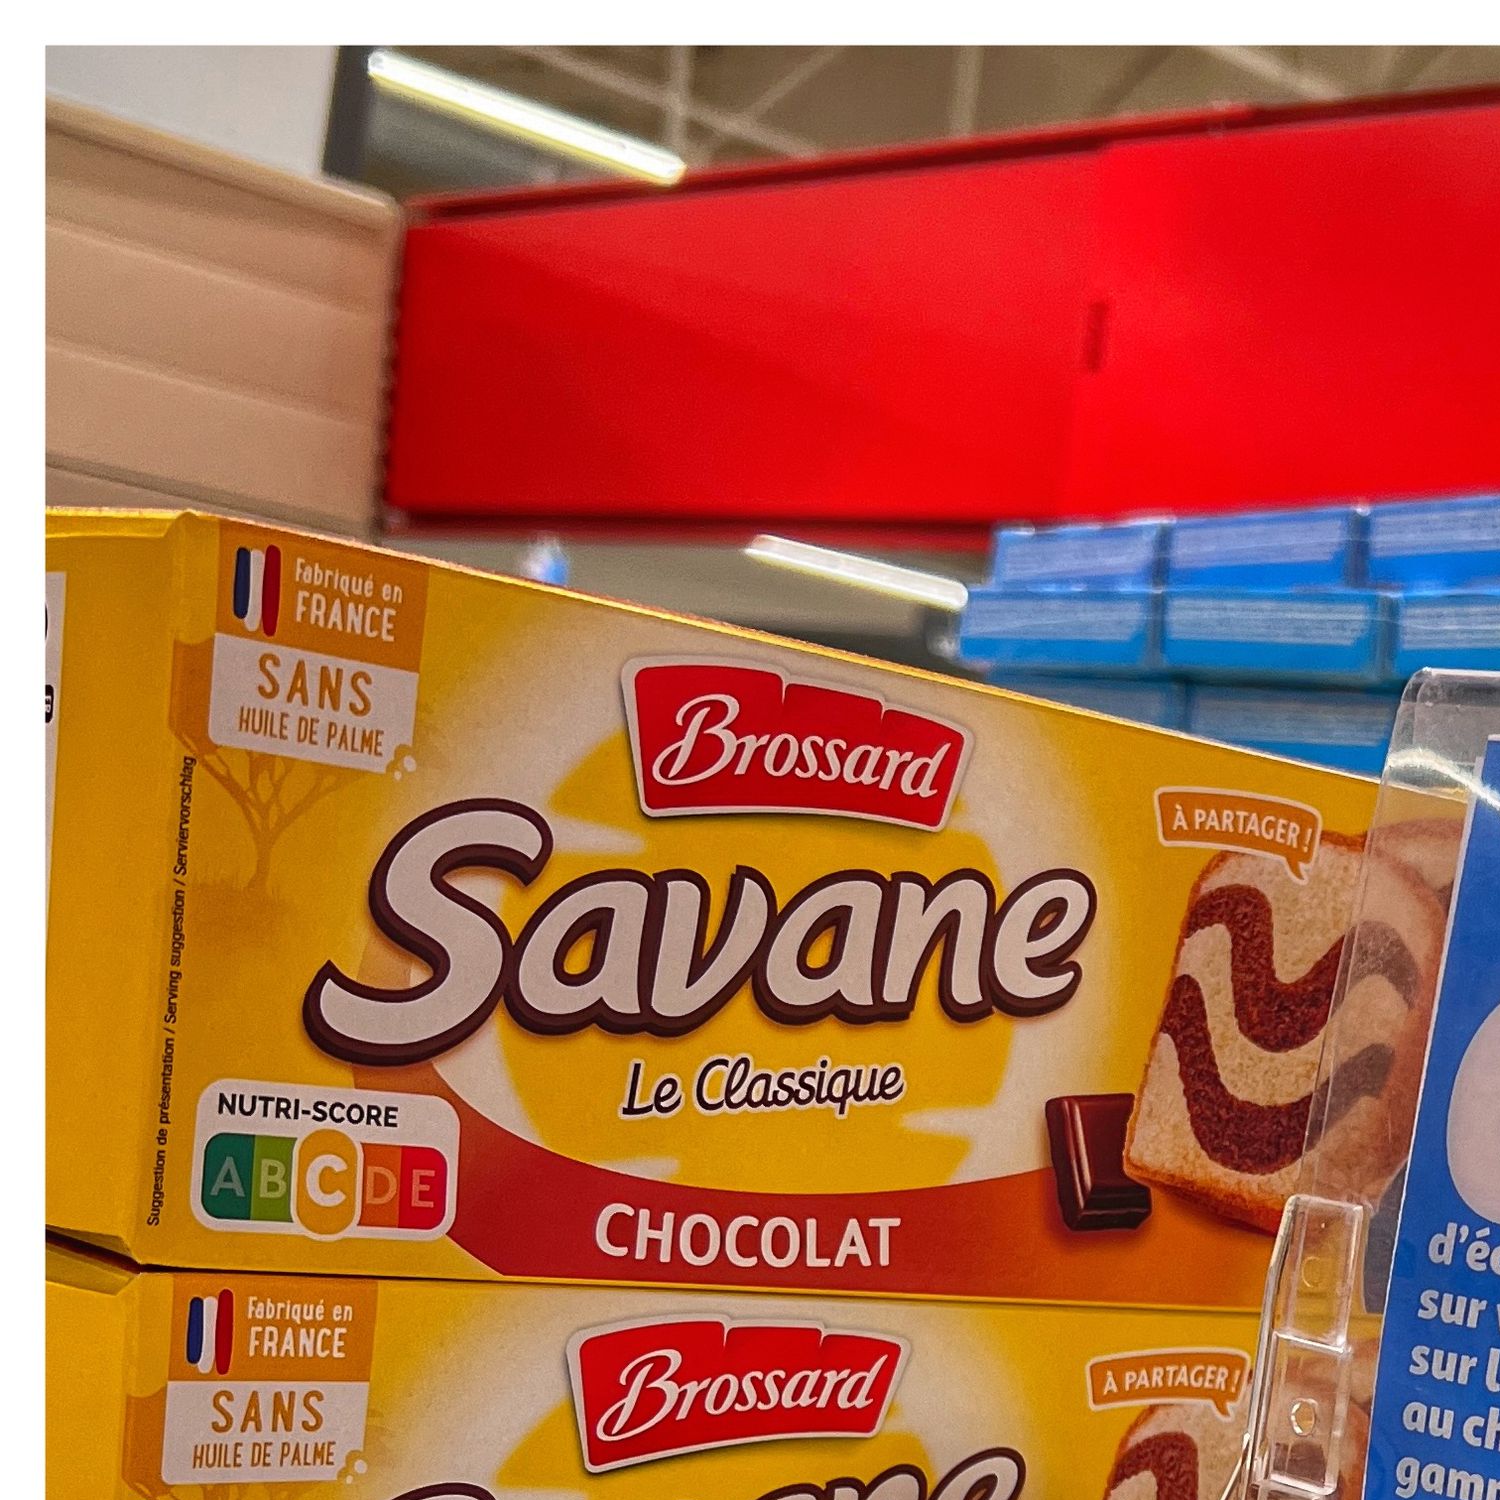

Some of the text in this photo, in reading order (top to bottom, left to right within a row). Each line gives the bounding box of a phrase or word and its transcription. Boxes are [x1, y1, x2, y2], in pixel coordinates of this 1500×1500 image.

[295, 557, 403, 604] Fabriqué en
[296, 590, 397, 643] FRANCE
[257, 652, 373, 718] SANS
[238, 705, 385, 757] HUILE DE PALME
[653, 690, 953, 800] Brossard
[1172, 803, 1188, 831] À
[303, 797, 1097, 1068] Savane
[146, 755, 197, 1227] Suggestion de présentation Serving suggestion Serviervorschlag
[623, 1057, 903, 1114] Le Classique
[217, 1091, 399, 1129] NUTRI-SCORE
[594, 1202, 901, 1268] CHOCOLAT
[247, 1295, 353, 1325] Fabriqué en
[1417, 1287, 1485, 1330] sur
[248, 1326, 348, 1358] FRANCE
[1409, 1342, 1478, 1386] sur
[596, 1349, 890, 1442] Brossard
[1102, 1368, 1118, 1395] À
[211, 1389, 325, 1434] SANS
[1402, 1400, 1453, 1441] au
[192, 1440, 337, 1469] HUILE DE PALME
